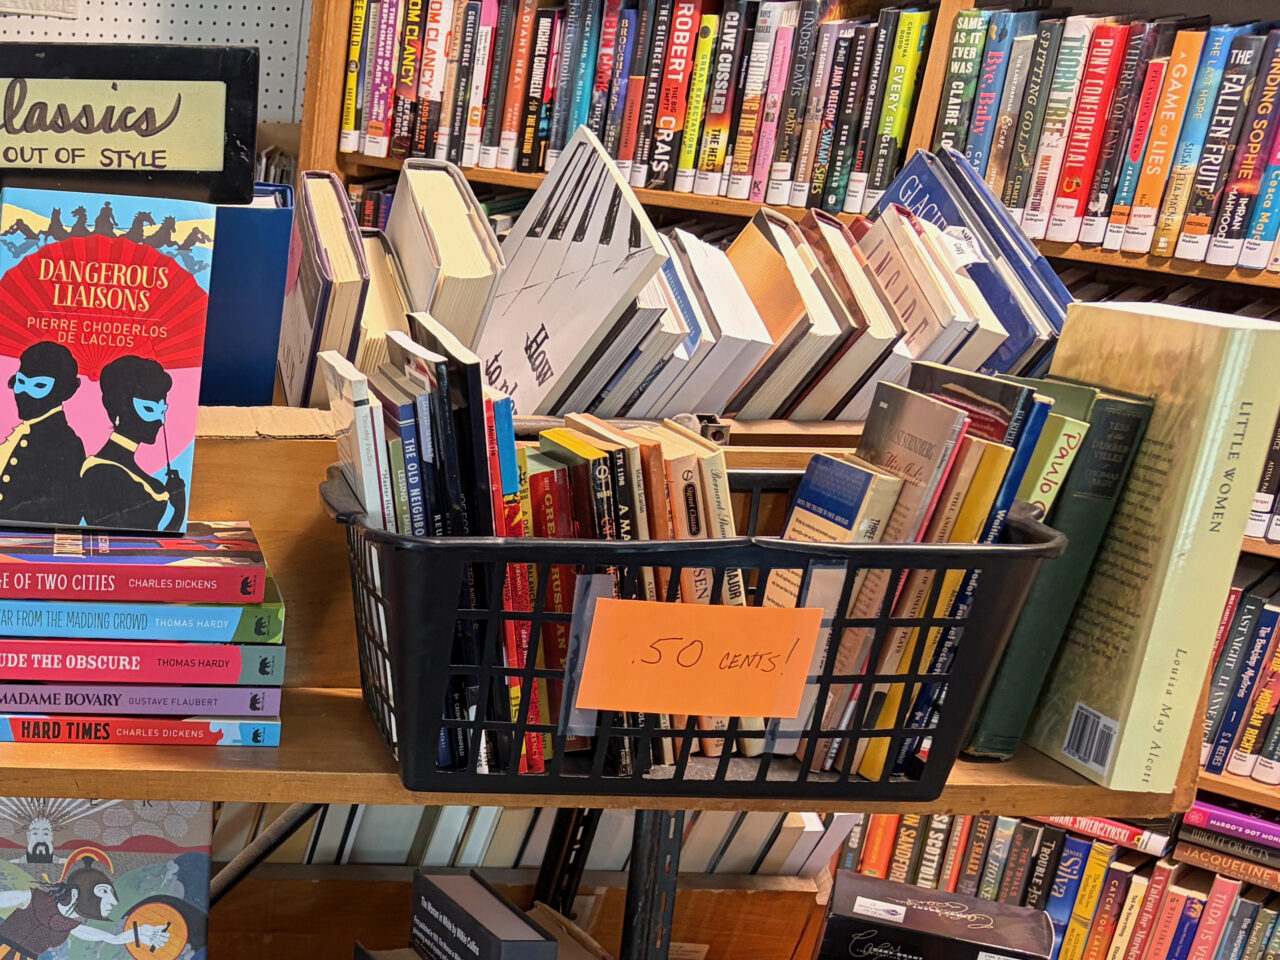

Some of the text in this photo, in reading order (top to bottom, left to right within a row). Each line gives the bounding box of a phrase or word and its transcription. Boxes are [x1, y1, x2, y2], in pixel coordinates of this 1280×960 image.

[954, 32, 982, 43] AS IT
[957, 17, 984, 29] SAME
[400, 26, 419, 86] CLANCY
[668, 3, 694, 82] ROBERT
[952, 47, 977, 59] EVER
[1232, 50, 1253, 64] THE
[711, 11, 739, 114] CLIVE CUSSLER
[951, 62, 973, 73] WAS
[944, 81, 965, 126] CLAIRE
[1065, 38, 1114, 168] PONY CONFIDENTIAL
[653, 116, 676, 173] CRAIS
[1196, 74, 1247, 193] FALLEN FRUIT
[3, 146, 48, 163] OUT
[55, 148, 85, 163] OF
[100, 149, 167, 169] STYLE
[39, 258, 169, 289] DANGEROUS
[52, 284, 150, 312] LIAISONS
[27, 317, 167, 338] PIERRE CHODERLOS
[58, 331, 134, 347] DE LACLOS
[1038, 431, 1083, 494] Paulo
[1210, 401, 1253, 533] LITTLE WOMEN
[14, 573, 33, 589] OF
[36, 573, 67, 591] TWO
[72, 575, 115, 591] CITIES
[128, 578, 172, 589] CHARLES
[175, 579, 217, 589] DICKENS
[16, 610, 43, 627] FROM
[45, 610, 63, 628] THE
[66, 611, 109, 629] MADDING
[113, 612, 147, 630] CROWD
[155, 618, 193, 628] THOMAS
[196, 619, 228, 628] HARDY
[31, 653, 62, 669] THE
[66, 654, 140, 670] OBSCURE
[631, 638, 799, 677] .50 CENTS!
[1143, 648, 1187, 783] Louisa May Alcott
[21, 721, 110, 740] HARD TIMES
[1183, 850, 1270, 880] JACQUELINE
